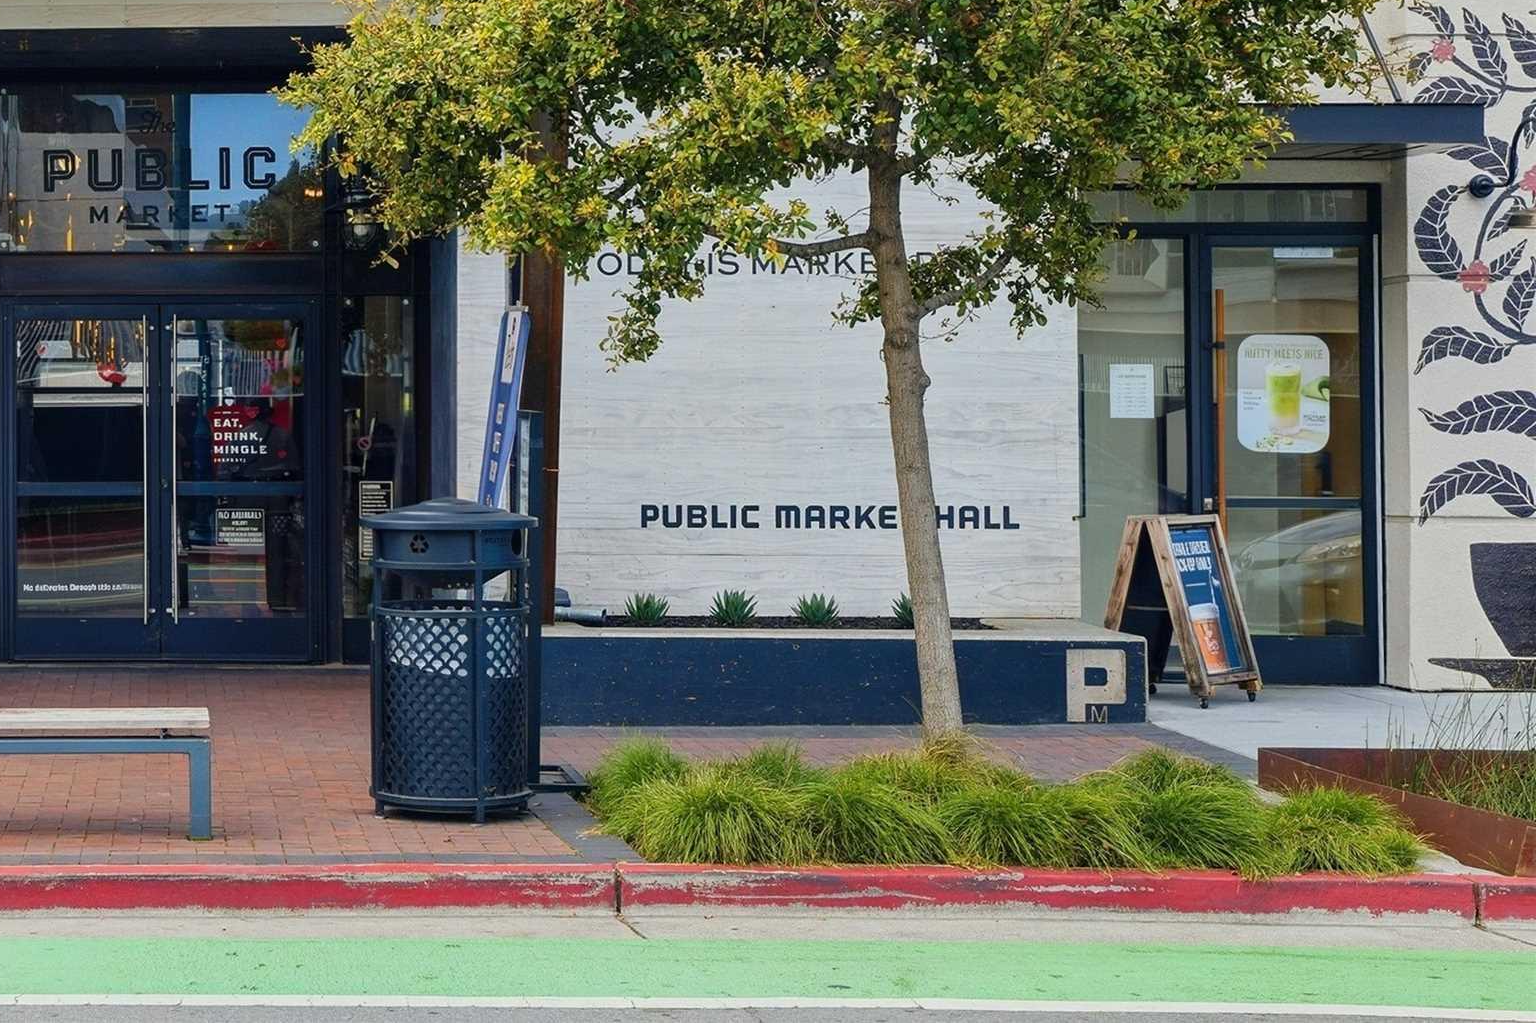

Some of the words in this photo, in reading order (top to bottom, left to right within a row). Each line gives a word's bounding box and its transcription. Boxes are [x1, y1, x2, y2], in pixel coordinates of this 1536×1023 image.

[42, 145, 277, 194] PUBLIC
[89, 203, 232, 225] MARKET
[706, 251, 740, 276] IS
[751, 251, 878, 275] MARKE
[213, 418, 243, 428] EAT.
[213, 431, 263, 443] DRINK,
[213, 444, 268, 455] MINGLE
[640, 504, 761, 530] PUBLIC
[774, 504, 898, 531] MARKE
[935, 505, 1021, 531] HALL
